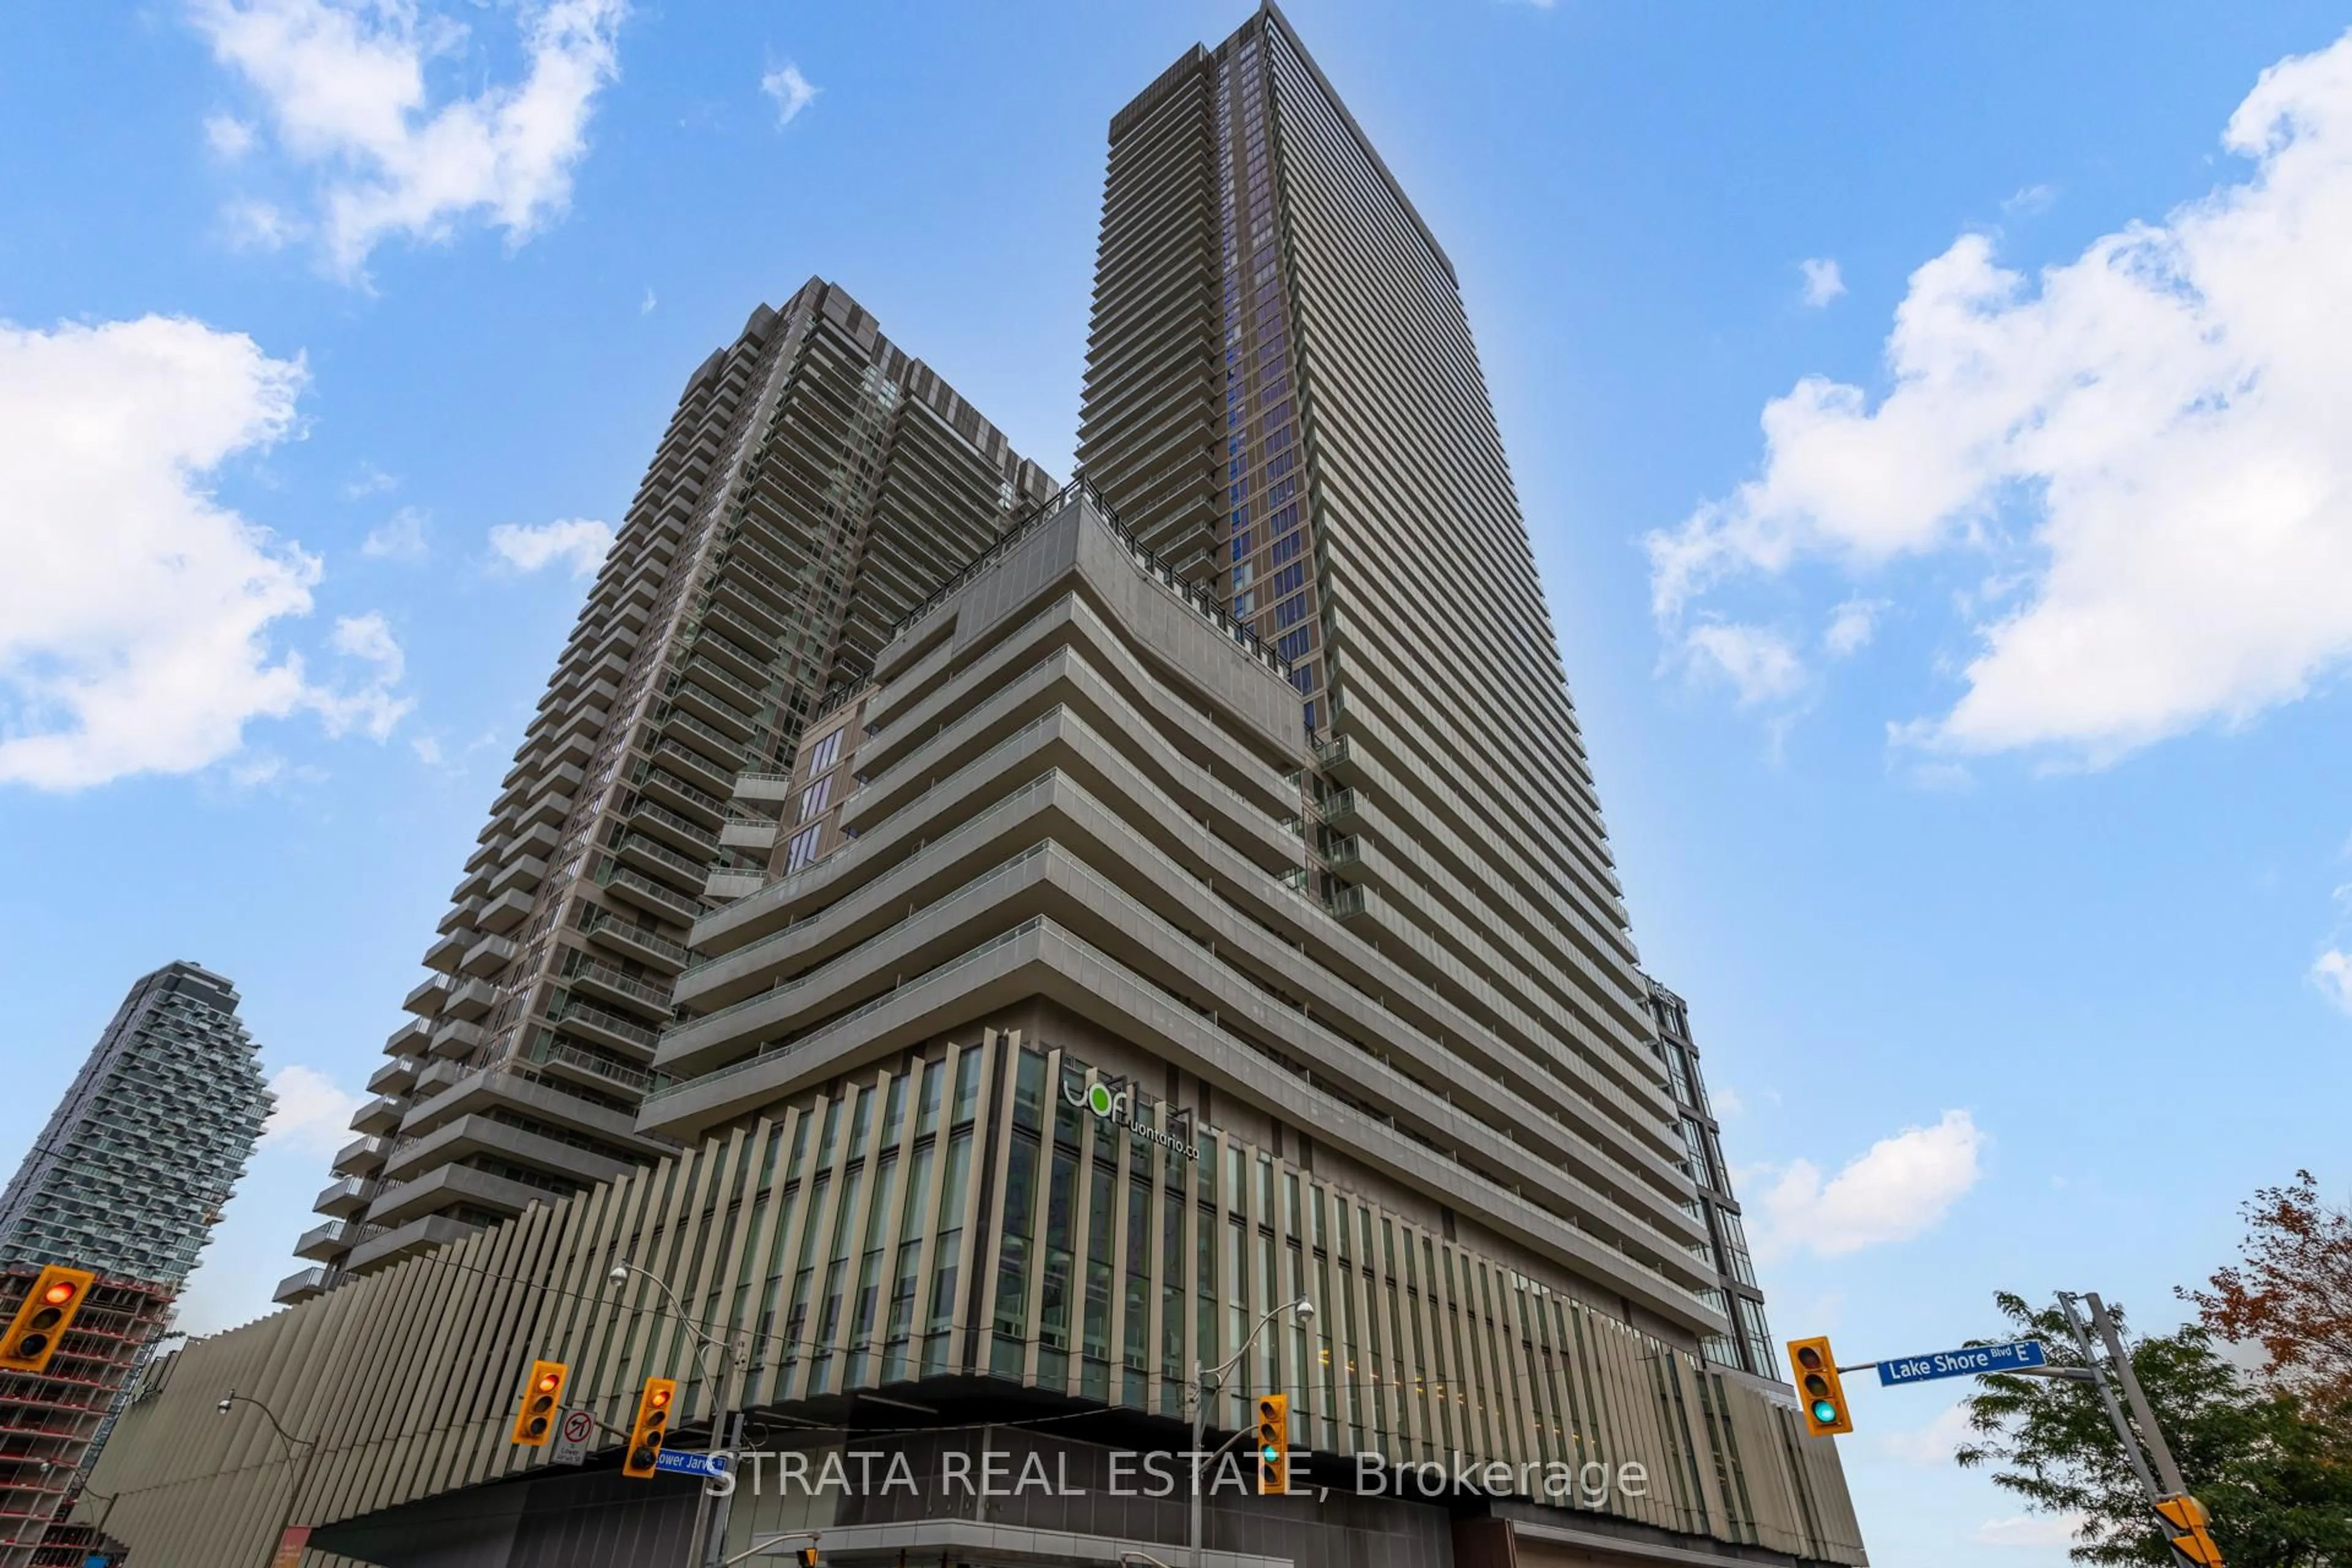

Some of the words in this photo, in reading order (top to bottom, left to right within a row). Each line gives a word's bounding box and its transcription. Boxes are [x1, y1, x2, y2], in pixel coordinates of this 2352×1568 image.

[1131, 1120, 1200, 1159] uontario.ca
[1890, 1360, 1931, 1379] Lake
[1934, 1352, 1989, 1373] Shore
[1991, 1346, 2013, 1358] Blvd
[2016, 1344, 2030, 1362] E
[657, 1453, 685, 1468] ower
